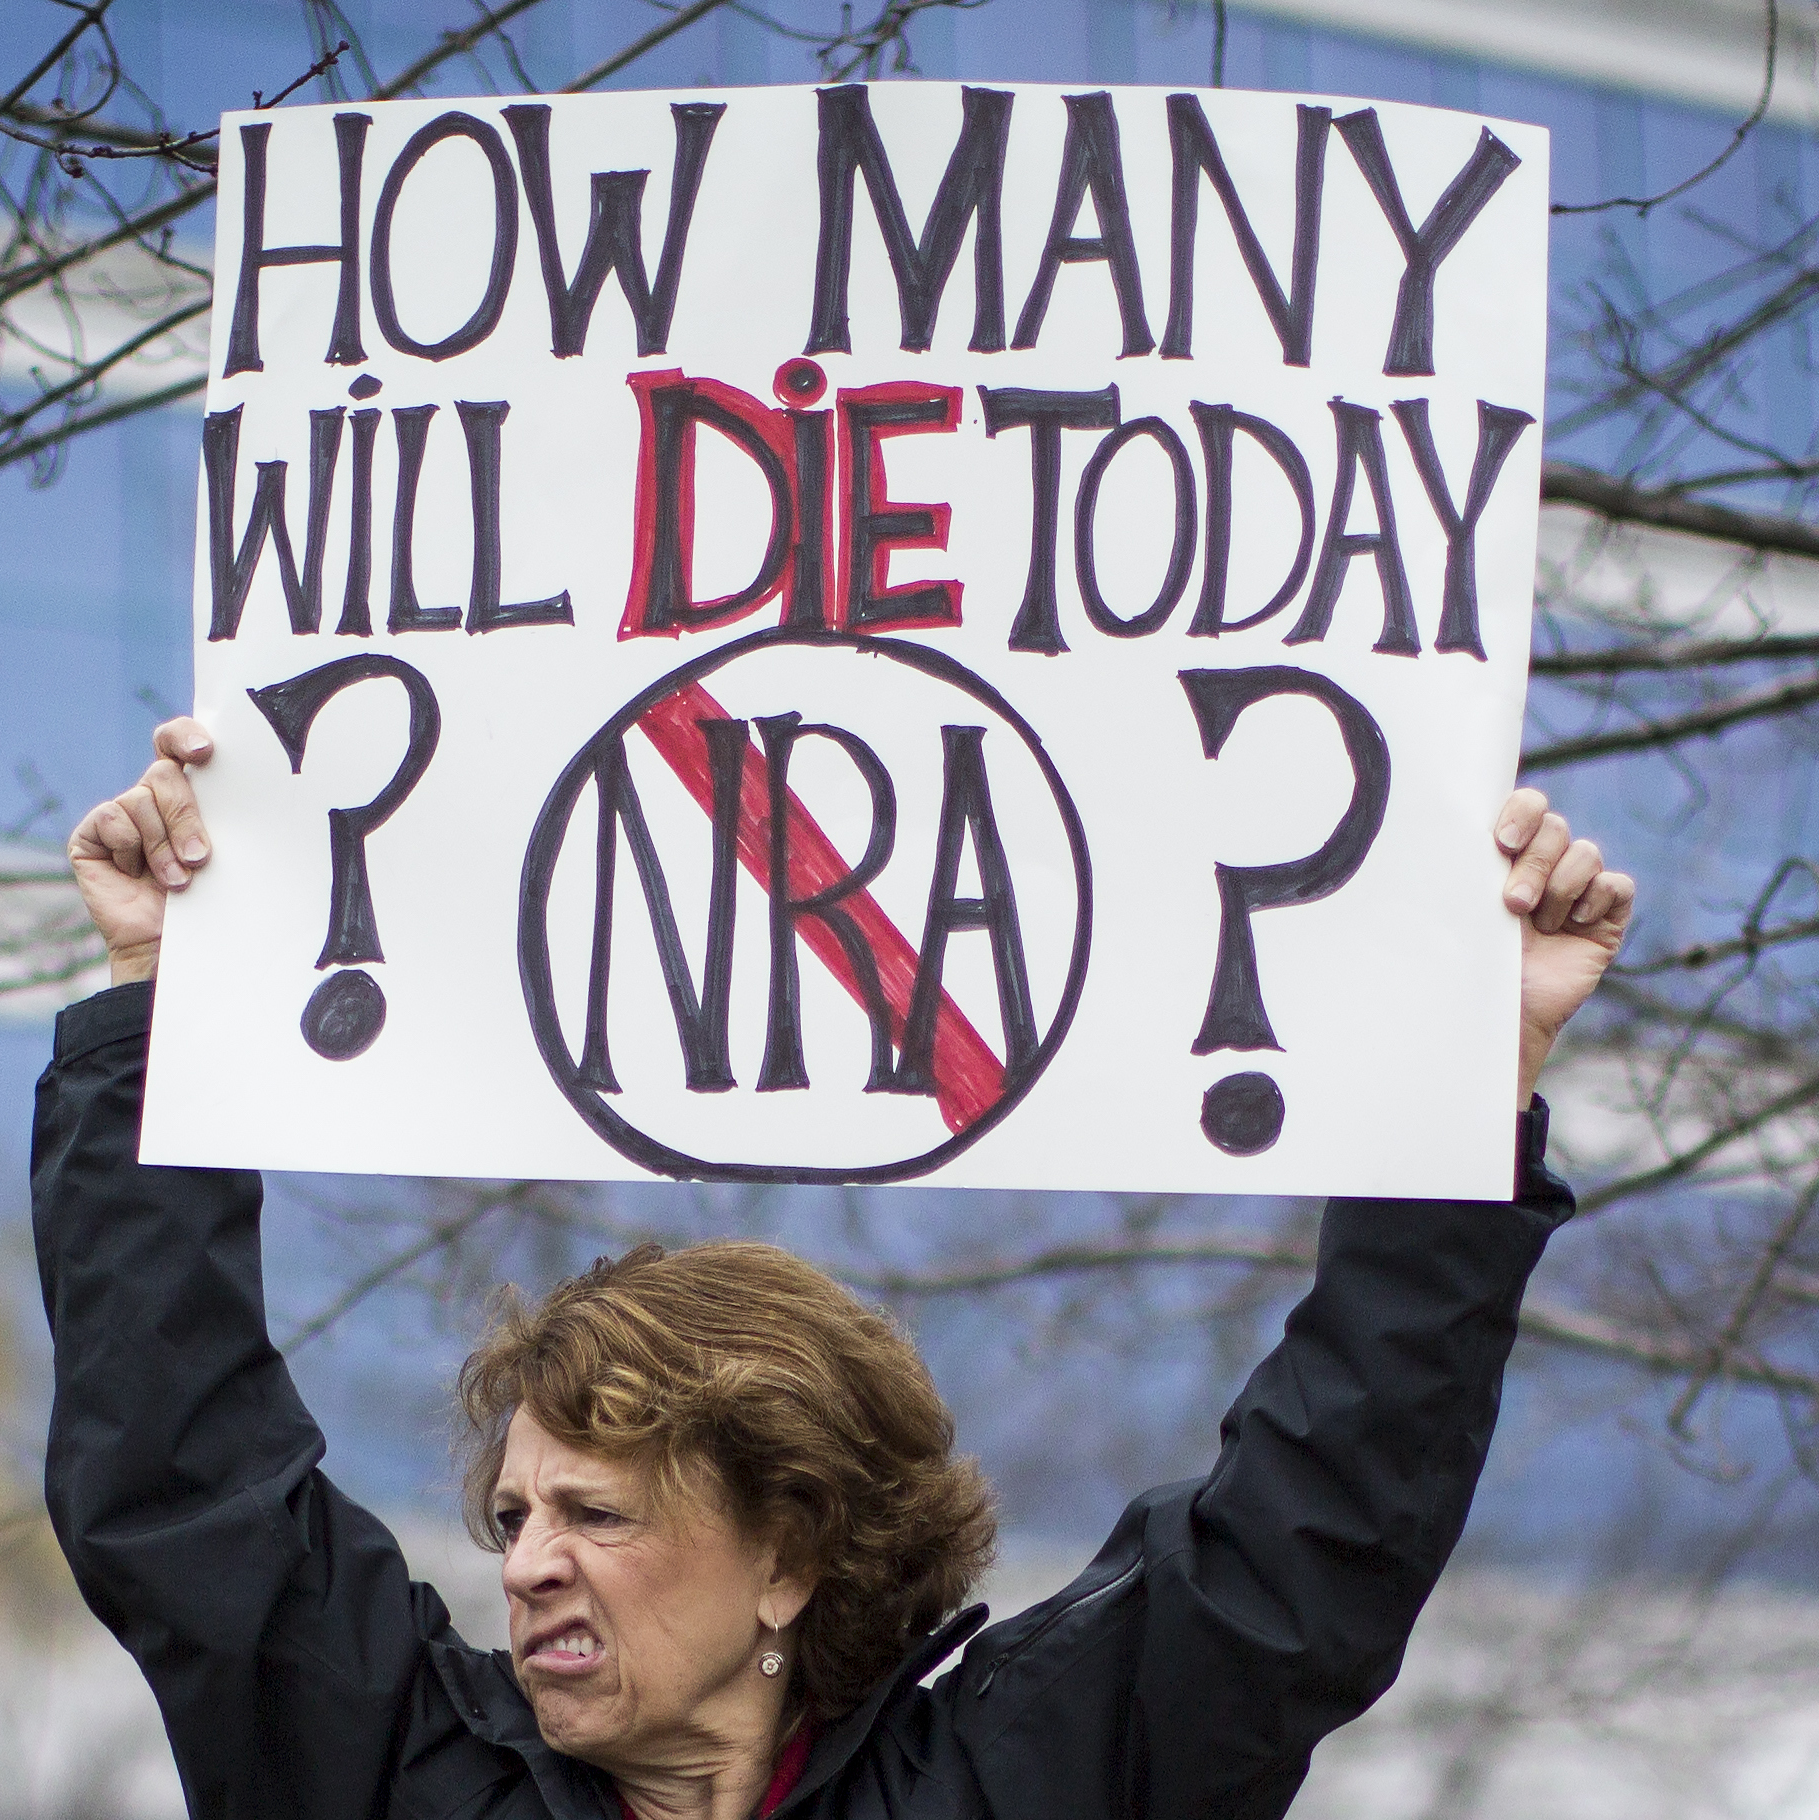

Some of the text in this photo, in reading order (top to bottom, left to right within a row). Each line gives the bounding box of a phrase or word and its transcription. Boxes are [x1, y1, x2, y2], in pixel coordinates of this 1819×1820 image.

[223, 82, 1522, 378] HOW MANY
[976, 382, 1536, 662] TODAY
[245, 652, 1393, 1157] ? NRA ?
